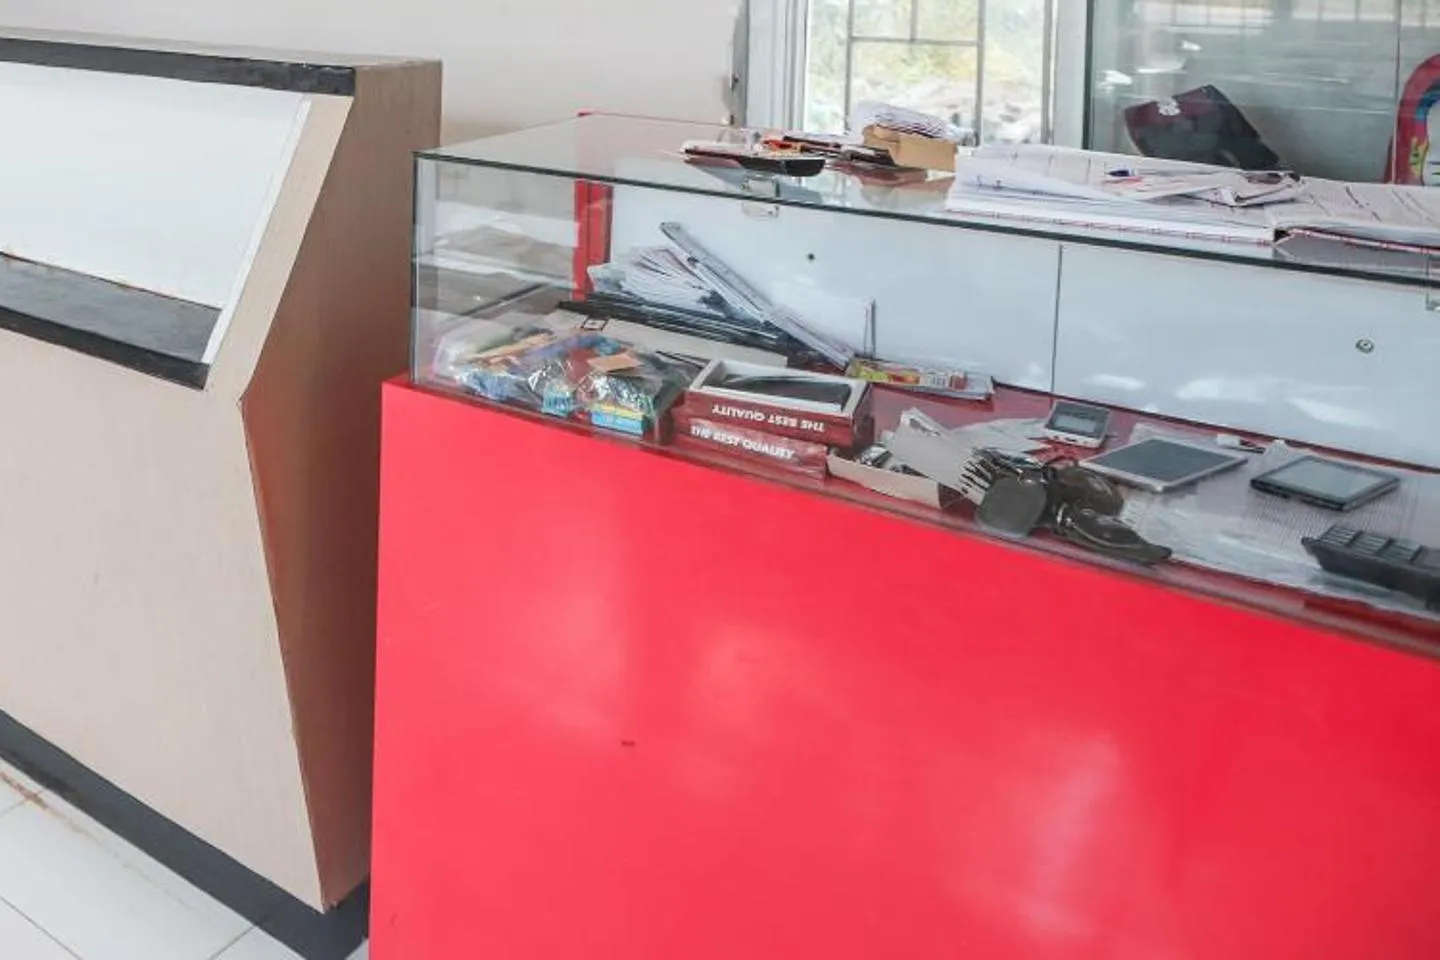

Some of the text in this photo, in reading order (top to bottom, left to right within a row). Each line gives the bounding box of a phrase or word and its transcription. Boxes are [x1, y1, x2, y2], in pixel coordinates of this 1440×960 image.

[711, 403, 825, 433] THE BEST QUALITY
